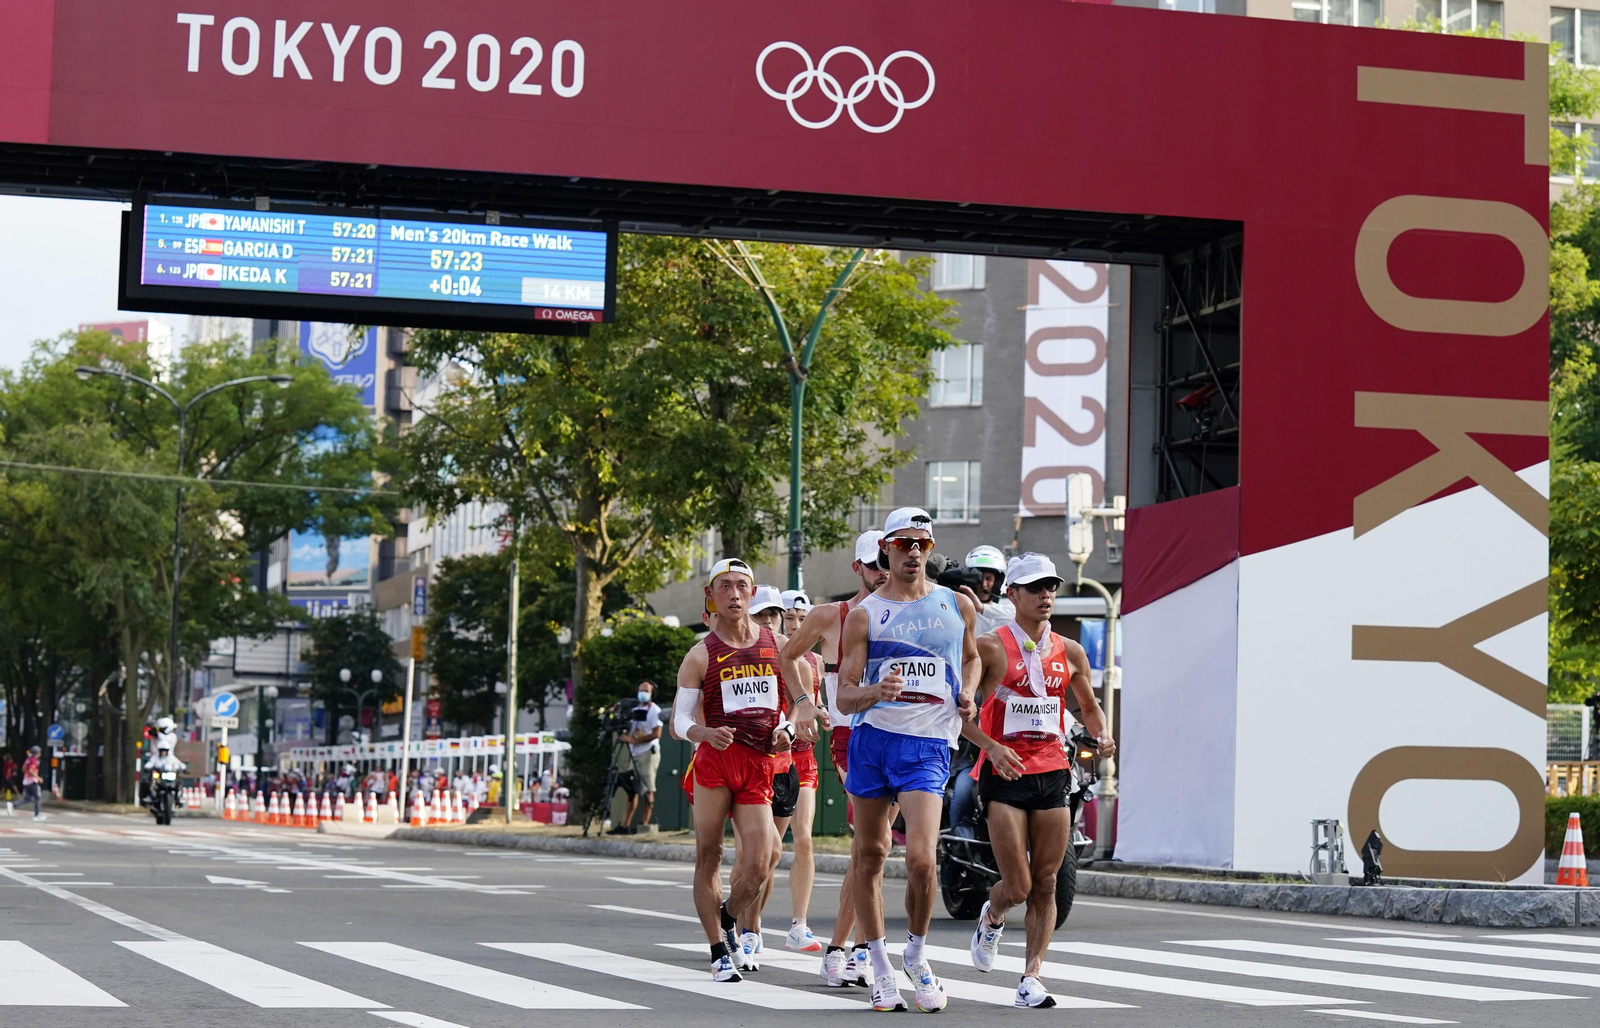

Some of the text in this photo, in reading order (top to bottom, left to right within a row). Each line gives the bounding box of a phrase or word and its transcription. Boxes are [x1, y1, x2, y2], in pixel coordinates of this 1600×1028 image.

[177, 13, 585, 98] TOKYO 2020
[224, 215, 295, 234] YAMANISHI
[298, 220, 306, 235] T
[332, 222, 376, 239] 57:20
[391, 225, 573, 250] Men's 20km Race Walk
[184, 238, 206, 255] ESP
[224, 240, 279, 258] GARCIA
[282, 244, 293, 259] D
[331, 246, 374, 264] 57:21
[431, 249, 483, 271] 57:23
[223, 265, 272, 283] IKEDA
[275, 268, 287, 284] K
[330, 271, 373, 289] 57:21
[429, 275, 482, 296] +0:04
[542, 284, 590, 301] 14 KM
[555, 310, 595, 321] OMEGA
[1021, 259, 1109, 516] 2020
[1348, 41, 1549, 882] TOKYO
[891, 617, 945, 638] ITALIA
[720, 663, 774, 681] CHINA
[890, 662, 936, 677] STANO
[732, 681, 769, 696] WANG
[907, 679, 920, 687] 118
[1011, 702, 1058, 715] YAMANISHI
